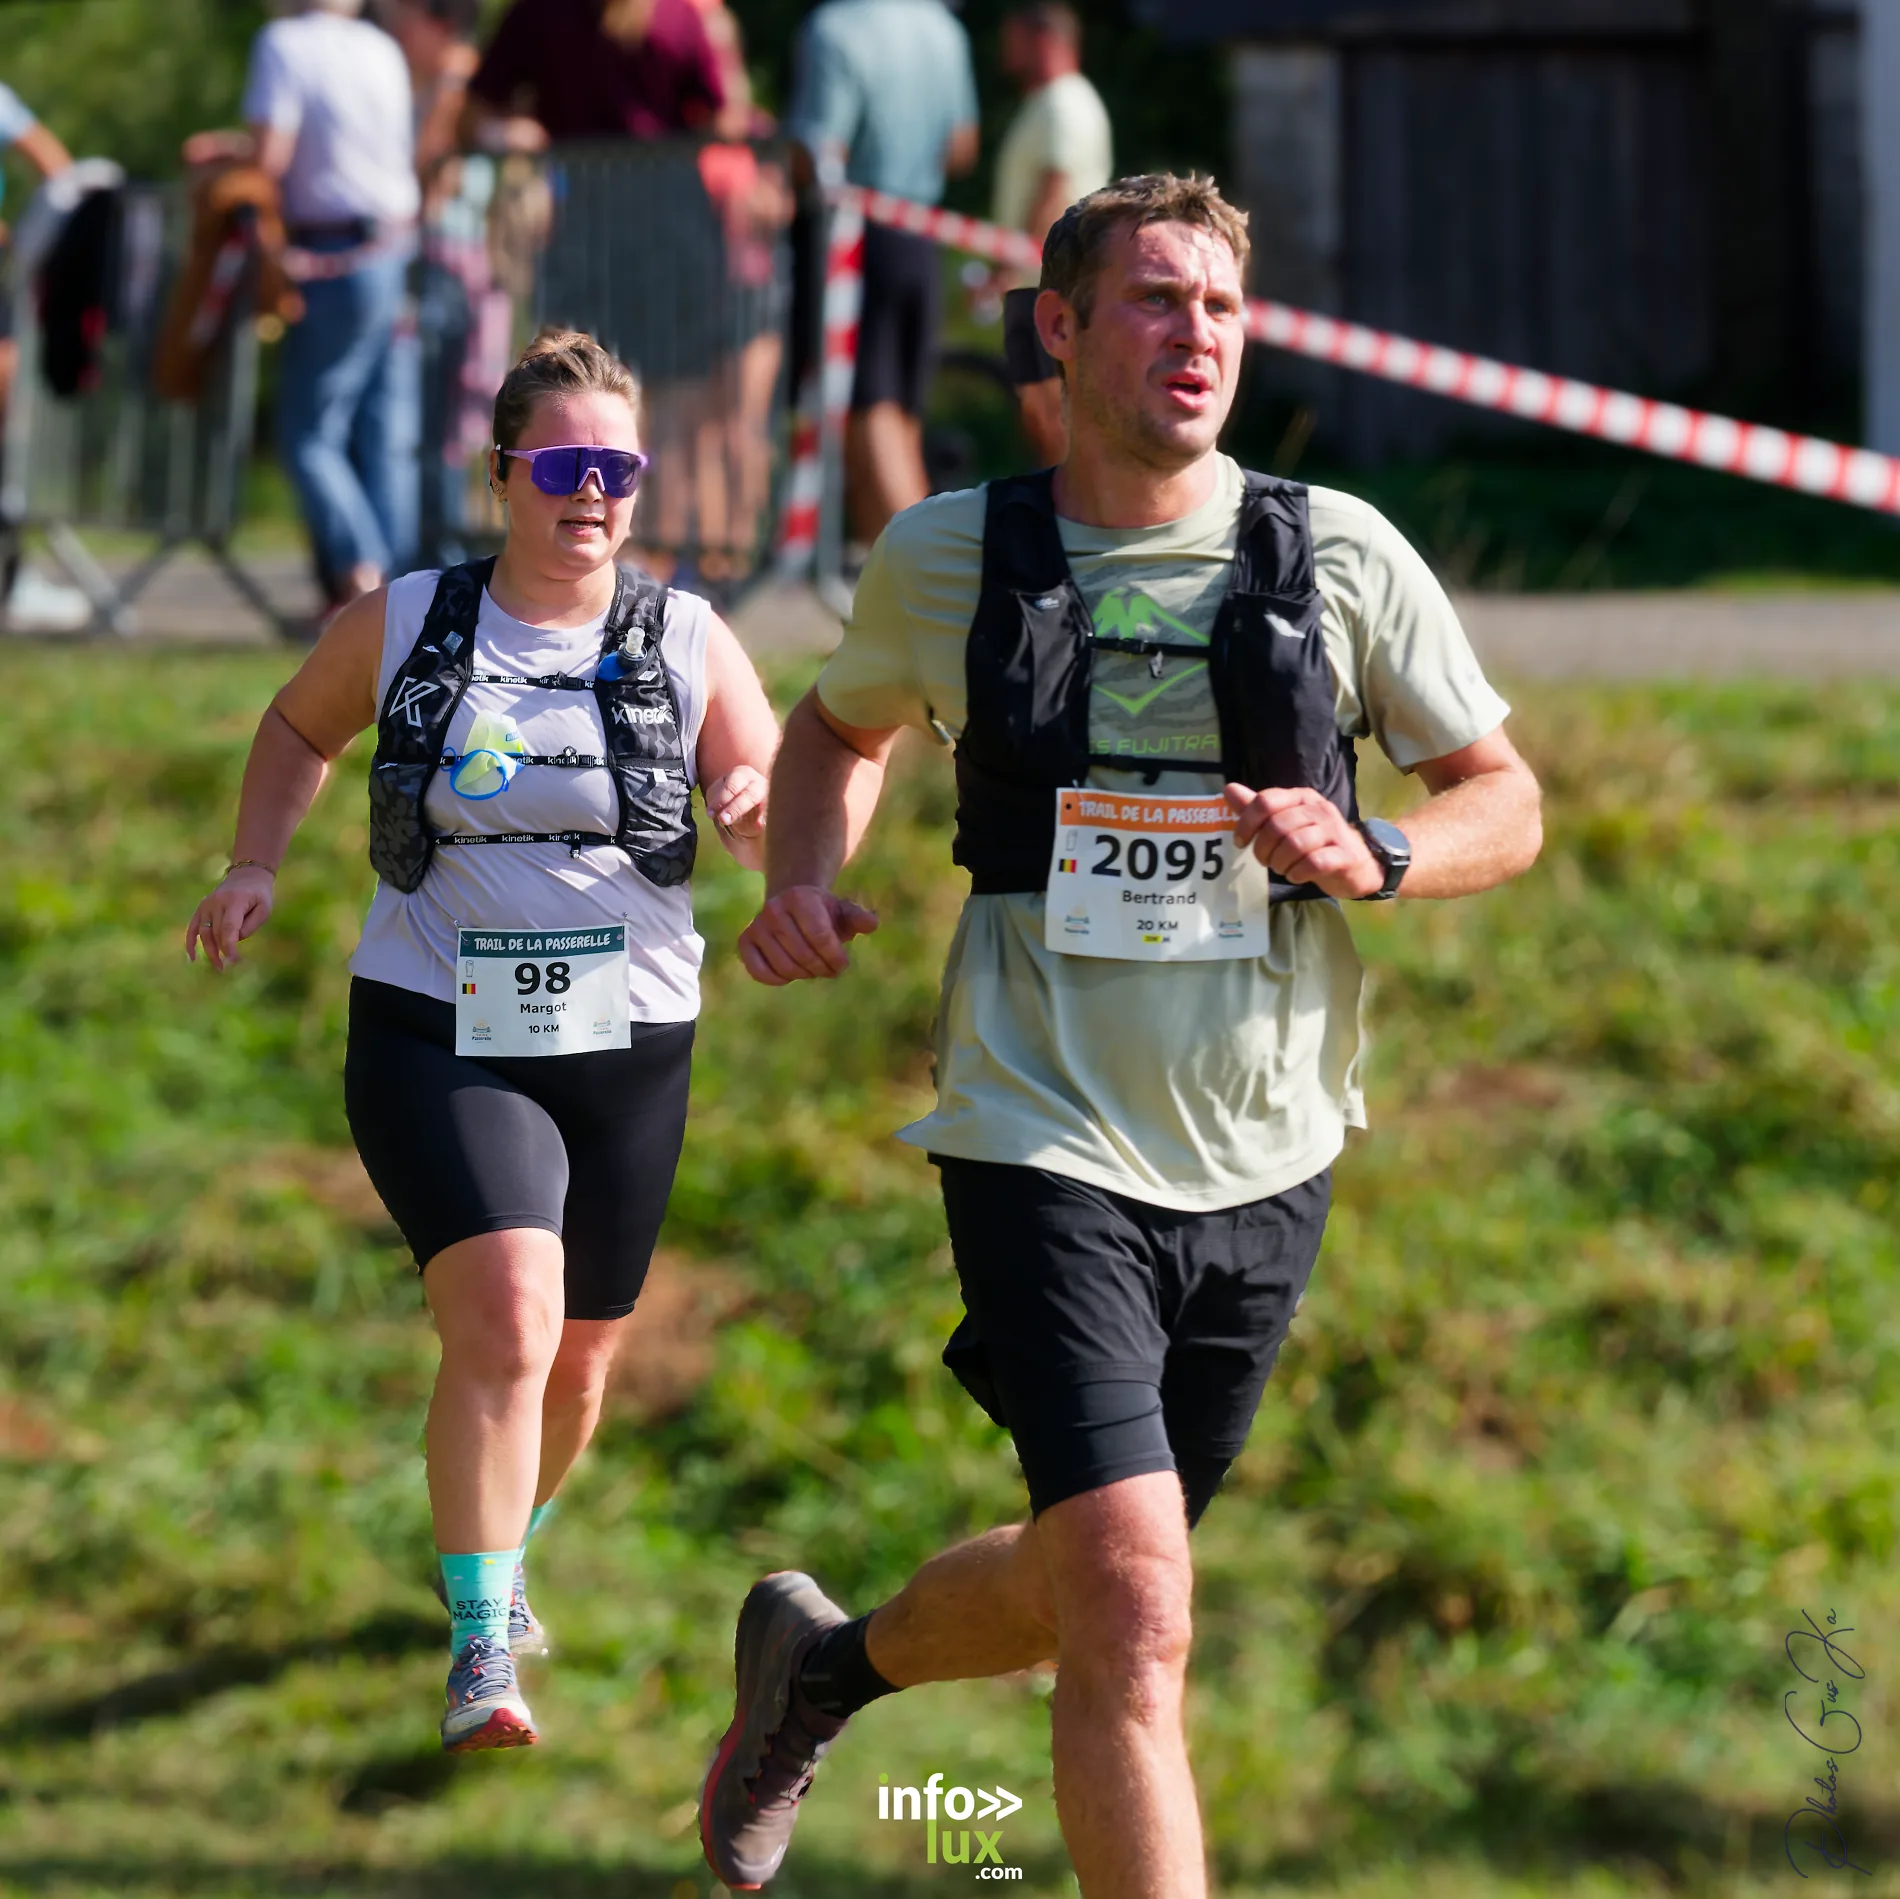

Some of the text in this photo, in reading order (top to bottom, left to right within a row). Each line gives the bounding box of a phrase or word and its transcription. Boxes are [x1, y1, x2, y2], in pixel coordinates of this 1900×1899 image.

[500, 676, 528, 685] kinetik
[611, 703, 674, 725] kinetik
[1116, 734, 1219, 755] FUJITRA
[1079, 800, 1118, 819] TRAIL
[1121, 805, 1141, 822] DE
[1143, 807, 1164, 824] LA
[454, 836, 488, 844] kinetik
[501, 834, 535, 843] kinetik
[1091, 834, 1224, 882] 2095
[1122, 890, 1198, 906] Bertrand
[1136, 919, 1179, 931] 20 KM
[474, 932, 611, 951] TRAIL DE LA PASSERELLE
[514, 961, 572, 996] 98
[520, 1002, 567, 1016] Margot
[528, 1024, 560, 1034] 10 KM
[456, 1598, 503, 1610] STAY
[453, 1607, 507, 1621] MAGIC
